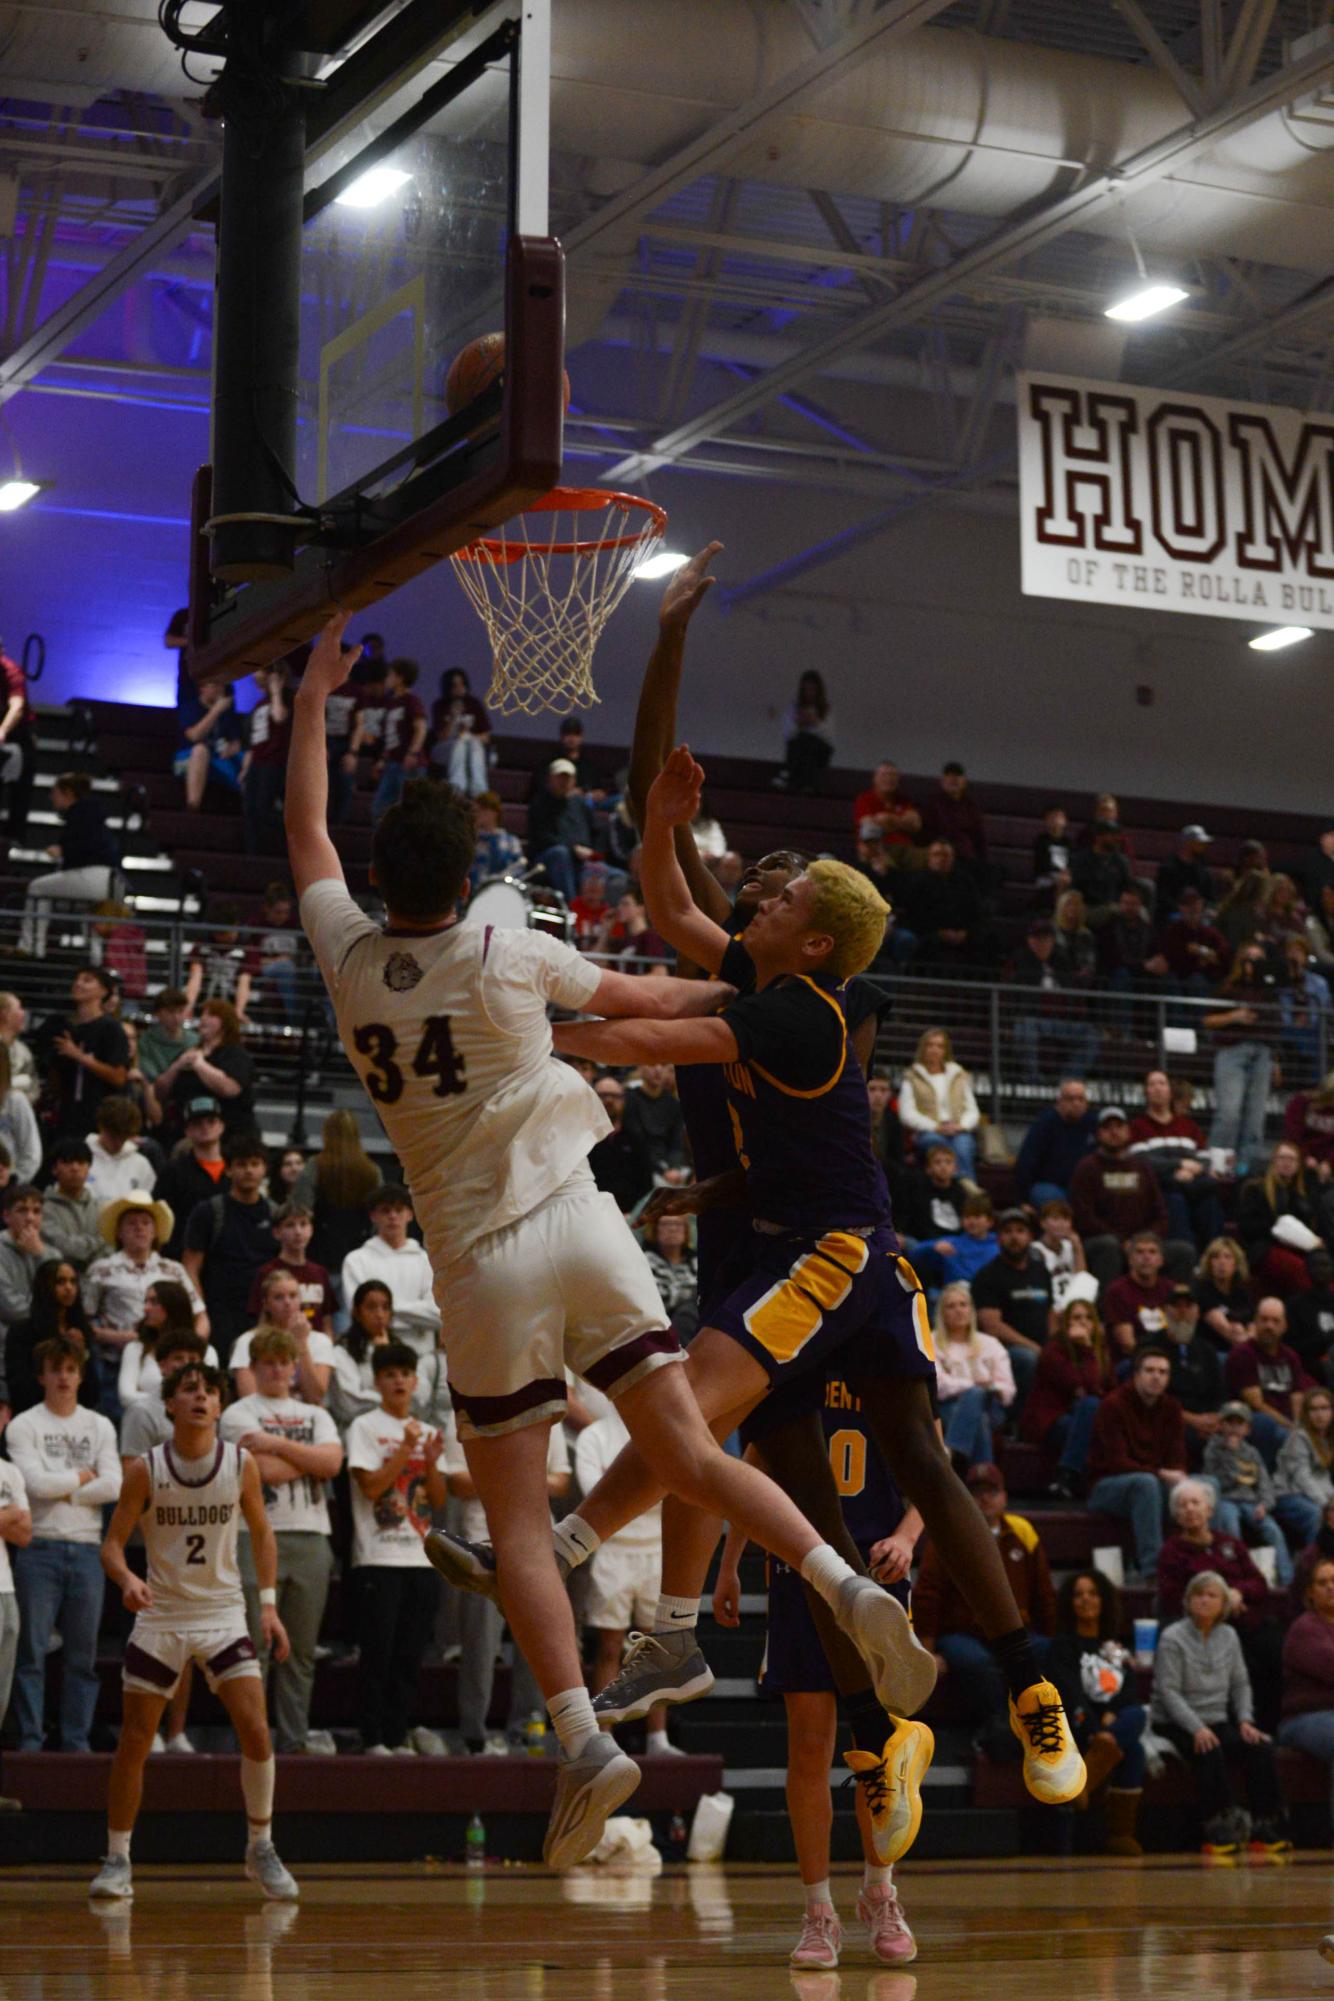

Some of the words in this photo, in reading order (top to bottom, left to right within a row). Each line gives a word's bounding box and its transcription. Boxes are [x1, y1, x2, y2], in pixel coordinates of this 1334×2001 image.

[1066, 557, 1100, 587] OF
[1112, 563, 1168, 595] THE
[1180, 570, 1269, 607] ROLLA
[353, 1014, 468, 1104] 34
[829, 1428, 867, 1497] 0
[186, 1534, 206, 1565] 2
